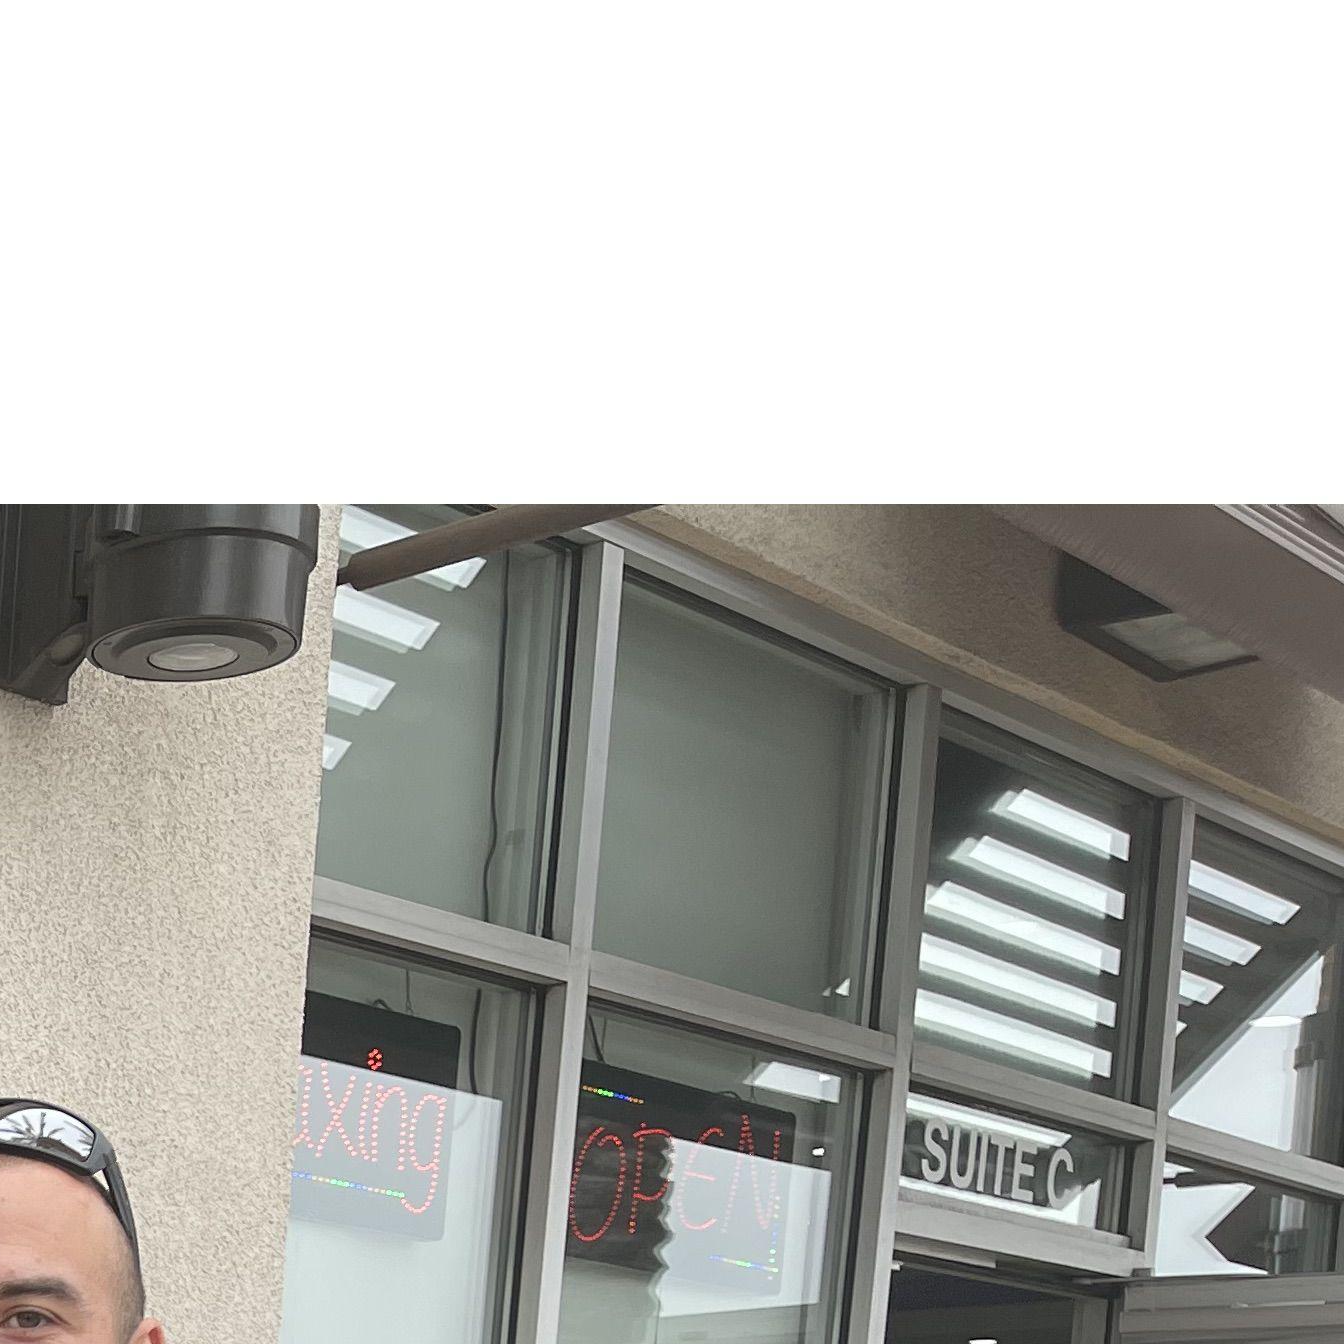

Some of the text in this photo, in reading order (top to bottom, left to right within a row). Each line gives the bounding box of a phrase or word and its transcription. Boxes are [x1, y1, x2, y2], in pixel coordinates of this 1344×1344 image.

[570, 1113, 781, 1242] OPEN
[921, 1119, 1074, 1209] SUITE C
